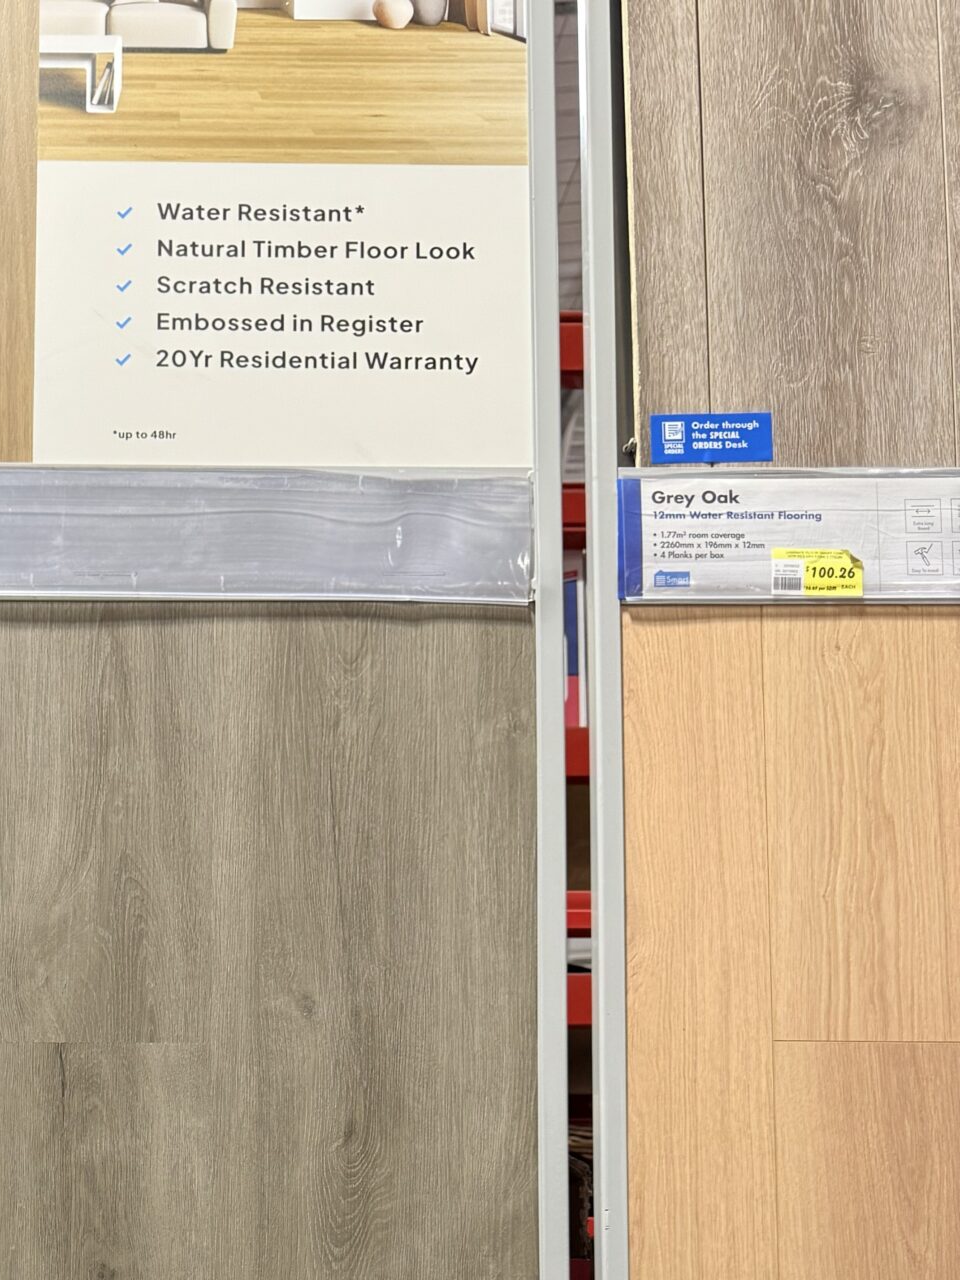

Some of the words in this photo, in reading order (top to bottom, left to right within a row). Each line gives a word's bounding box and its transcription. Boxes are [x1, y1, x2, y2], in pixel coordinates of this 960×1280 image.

[158, 203, 230, 222] Water
[158, 240, 245, 258] Natural
[253, 240, 338, 259] Timber
[345, 242, 408, 260] Floor
[416, 242, 475, 260] Look
[157, 276, 252, 294] Scratch
[260, 278, 375, 296] Resistant
[157, 313, 284, 332] Embossed
[293, 315, 313, 332] in
[321, 315, 424, 336] Register
[156, 350, 212, 368] 20Yr
[220, 350, 357, 370] Residential
[366, 352, 478, 374] Warranty
[692, 422, 720, 430] Order
[722, 421, 759, 430] through
[136, 431, 148, 440] to
[150, 430, 176, 440] 48hr
[710, 431, 740, 439] SPECIAL
[652, 490, 695, 507] Grey
[702, 490, 740, 504] Oak
[653, 511, 686, 520] 12mm
[690, 512, 724, 520] Water
[727, 512, 774, 520] Resistant
[778, 512, 822, 522] Flooring
[711, 532, 745, 540] coverage
[695, 552, 707, 560] per
[806, 566, 855, 579] $100.26
